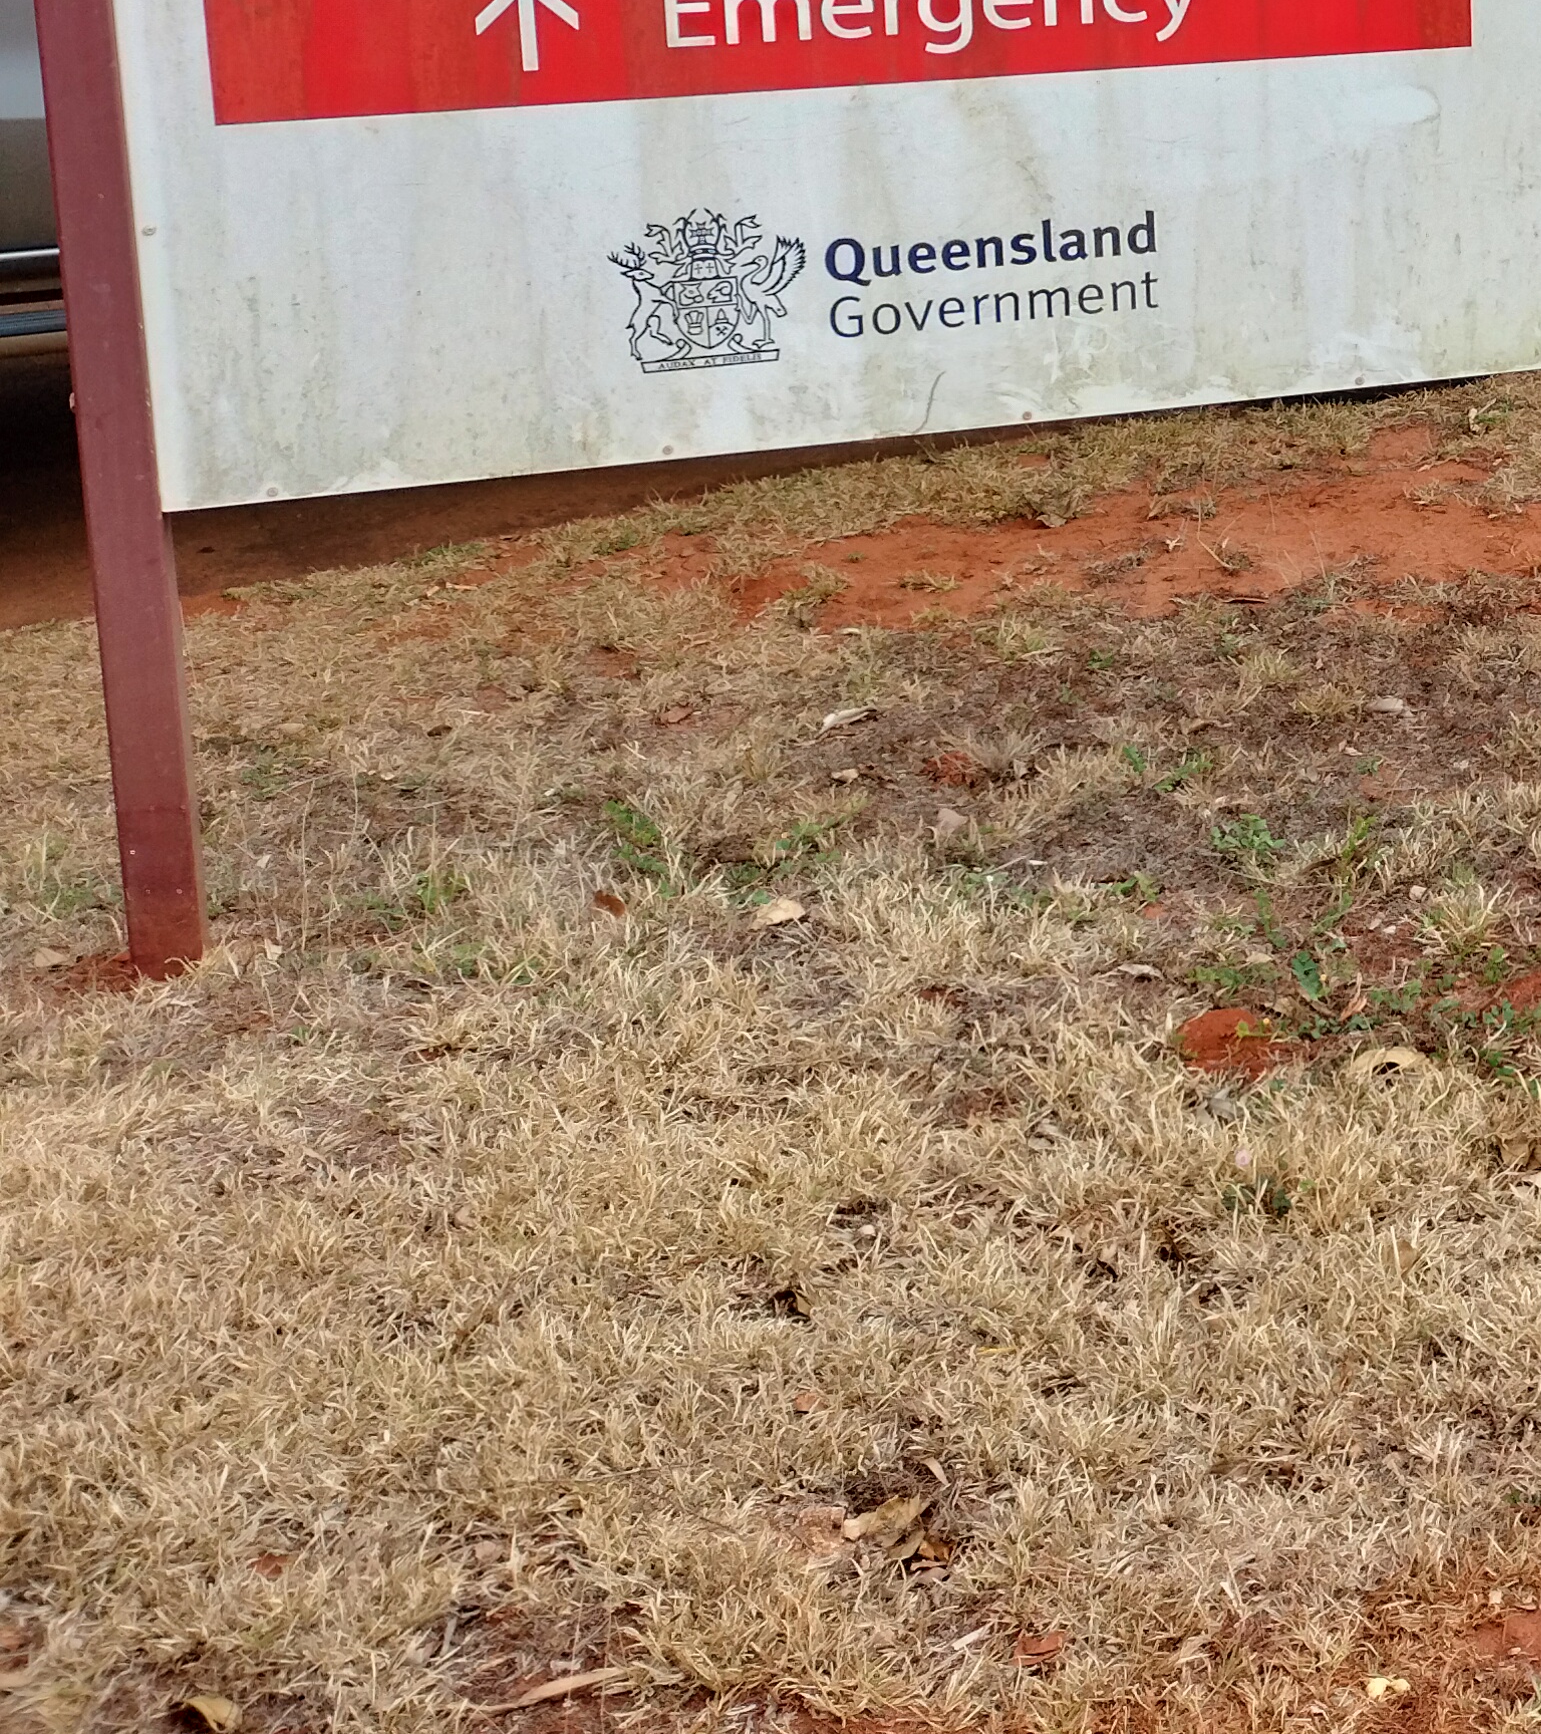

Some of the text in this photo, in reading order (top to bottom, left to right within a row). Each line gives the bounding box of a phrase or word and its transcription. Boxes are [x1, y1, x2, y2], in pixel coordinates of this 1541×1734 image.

[825, 210, 1158, 286] Queensland
[828, 271, 1159, 338] Government
[658, 353, 763, 370] AUDAX AT FIDELIS
